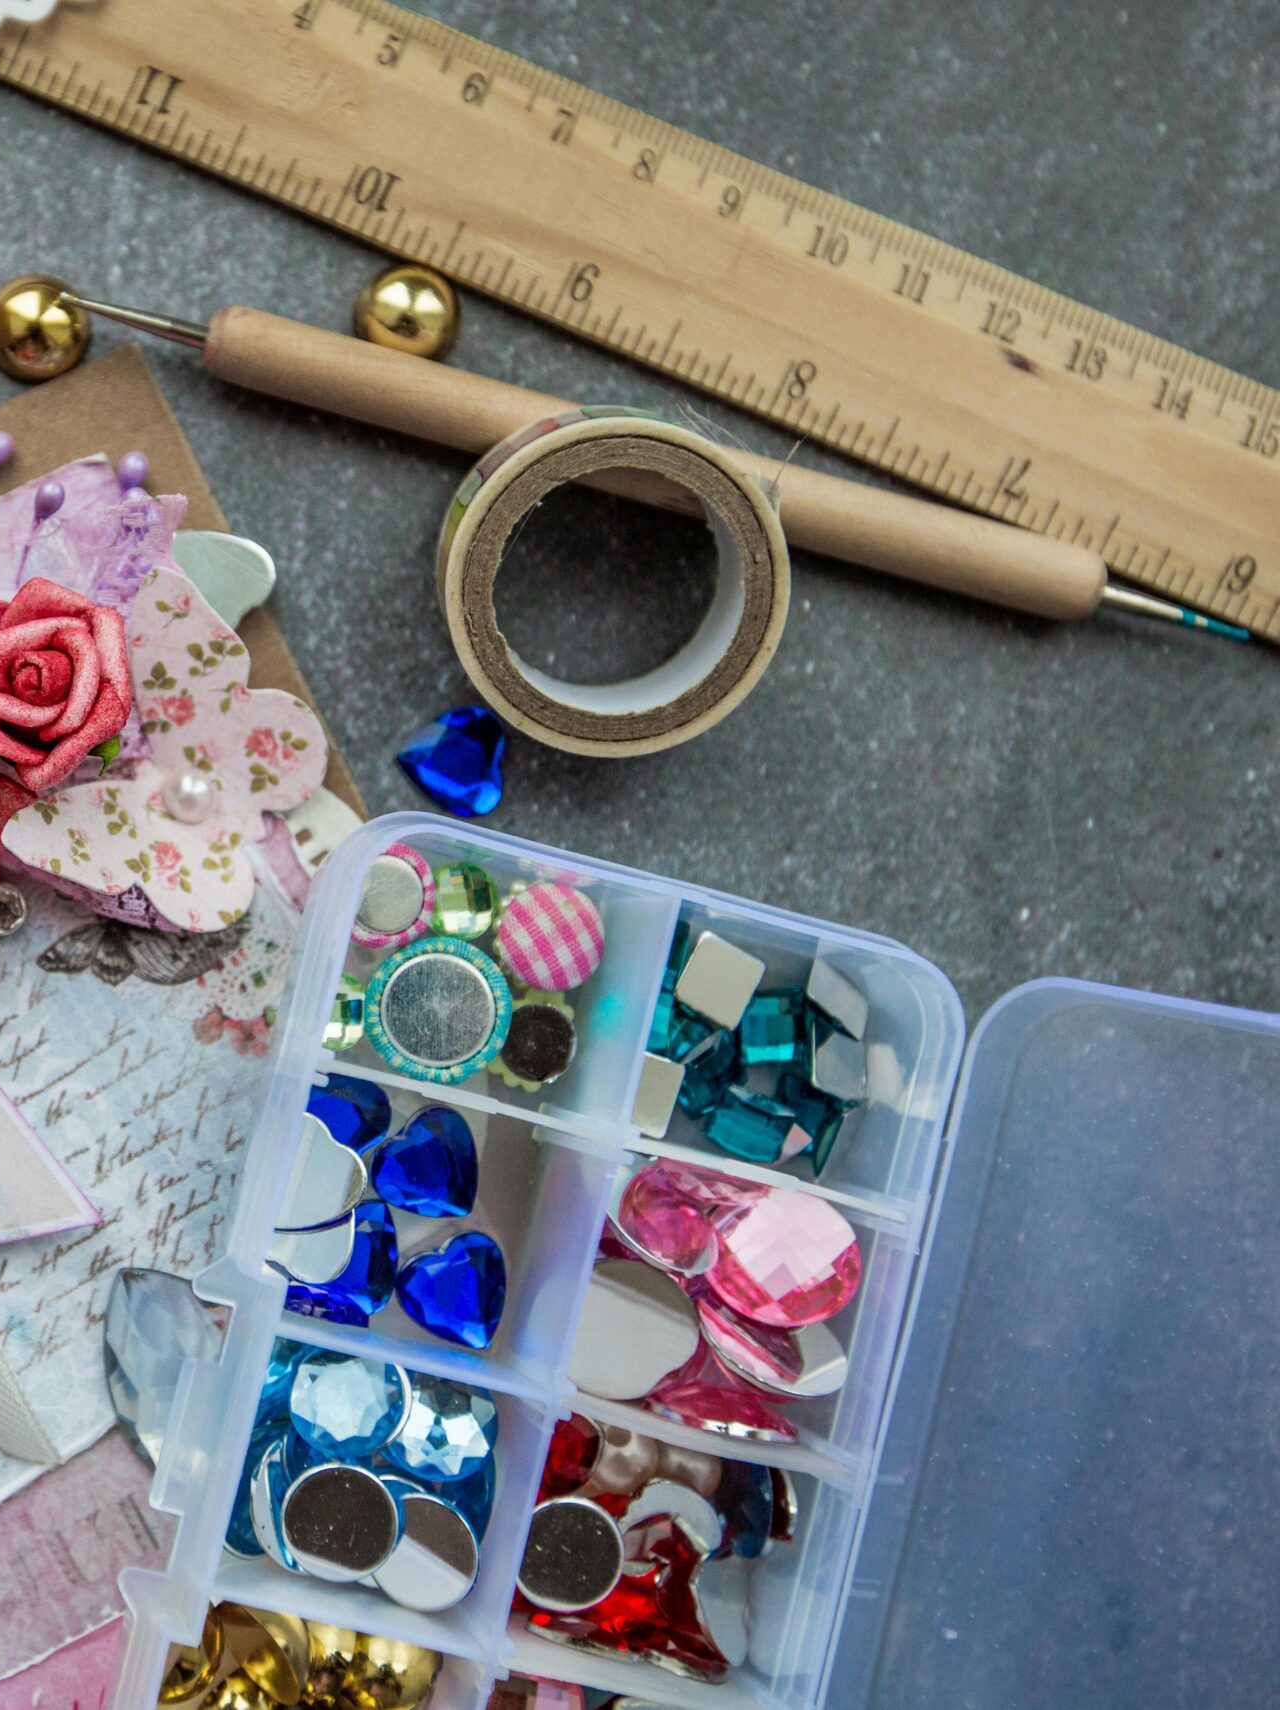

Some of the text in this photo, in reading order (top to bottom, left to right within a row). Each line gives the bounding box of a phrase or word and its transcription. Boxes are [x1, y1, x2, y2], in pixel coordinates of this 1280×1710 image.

[138, 66, 184, 114] 11
[354, 166, 403, 212] 10
[787, 359, 817, 401] 8
[1001, 455, 1032, 500] 7
[377, 34, 400, 66] 5
[462, 72, 486, 104] 6
[550, 109, 573, 143] 7
[632, 147, 656, 182] 8
[718, 184, 741, 218] 9
[806, 224, 851, 266] 10
[892, 263, 932, 304] 11
[978, 301, 1023, 342] 12
[1064, 339, 1108, 382] 13
[1151, 377, 1193, 422] 14
[1238, 414, 1280, 458] 15
